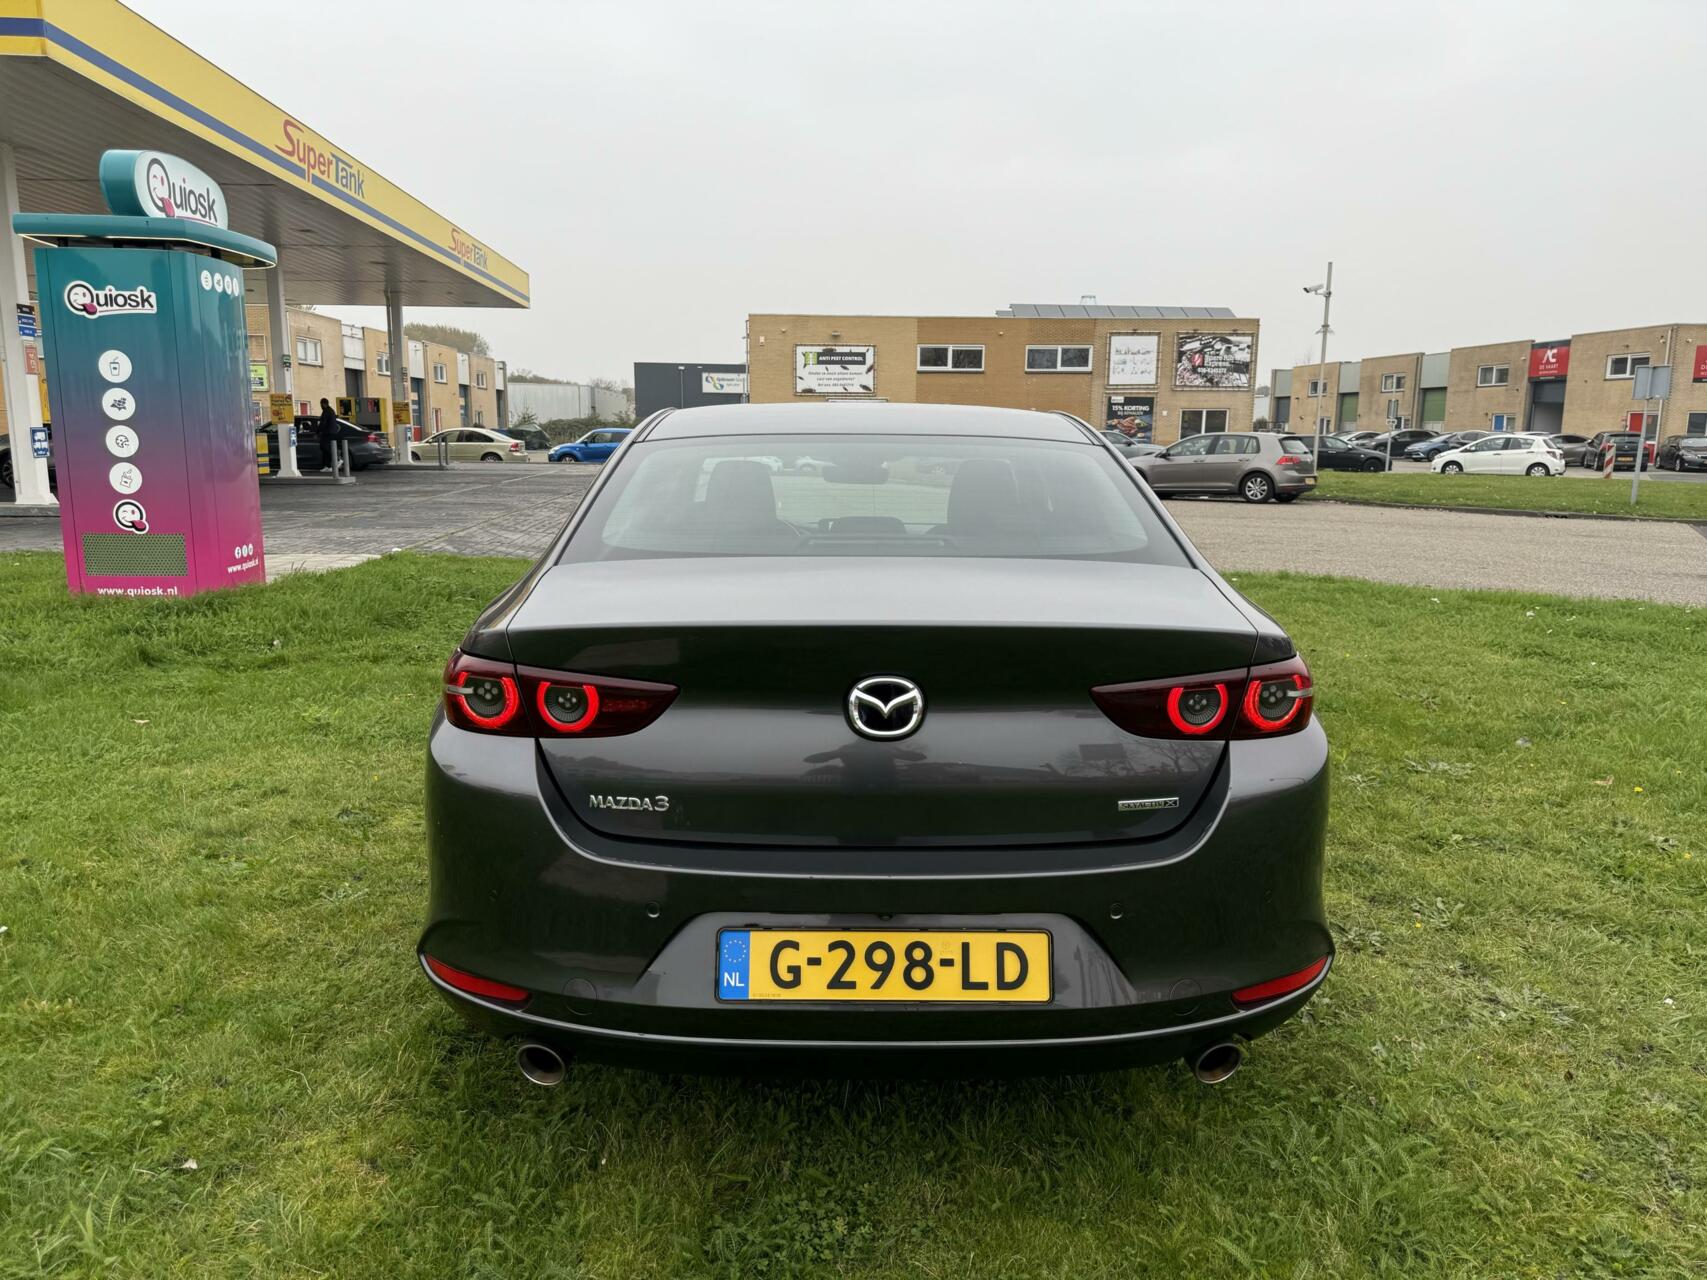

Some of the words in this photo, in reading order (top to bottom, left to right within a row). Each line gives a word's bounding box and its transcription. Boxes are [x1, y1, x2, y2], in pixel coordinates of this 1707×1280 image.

[147, 158, 218, 223] Quiosk
[67, 284, 154, 314] Quiosk
[98, 586, 178, 597] www.quiosk.nl
[723, 971, 745, 987] NL
[769, 939, 1029, 991] G-298-LD
